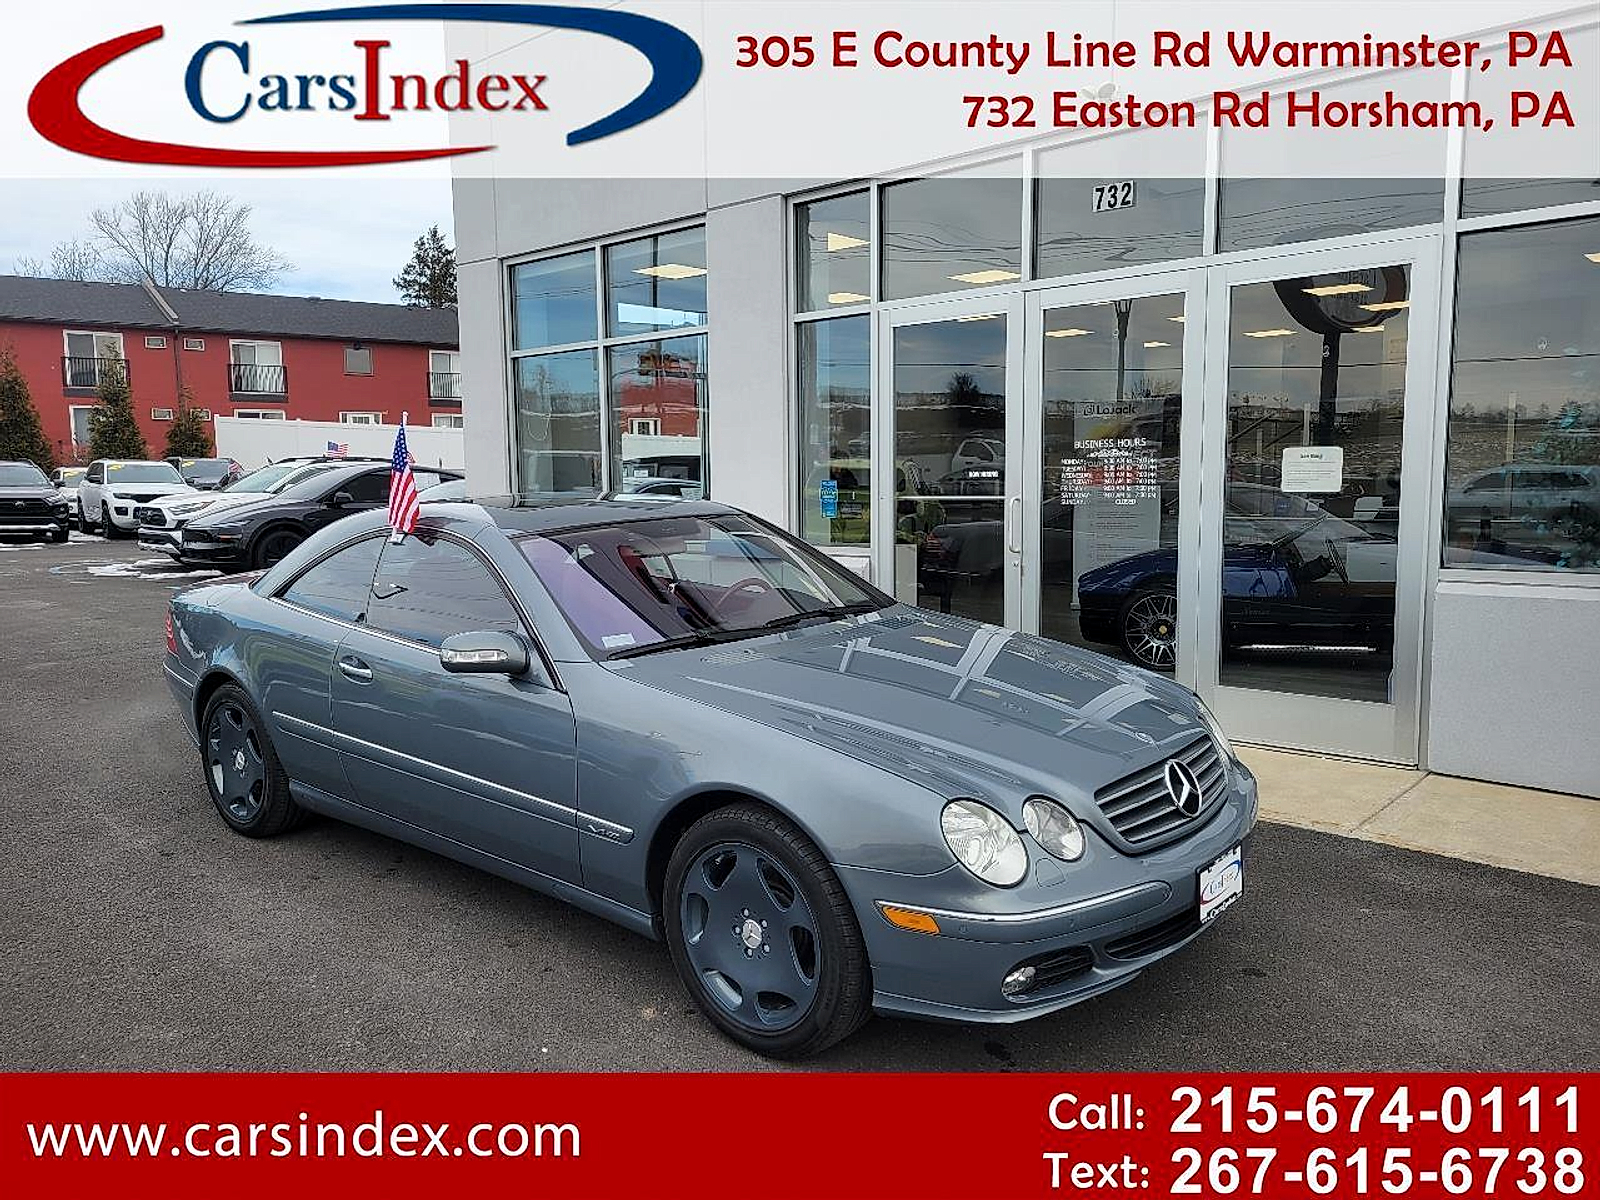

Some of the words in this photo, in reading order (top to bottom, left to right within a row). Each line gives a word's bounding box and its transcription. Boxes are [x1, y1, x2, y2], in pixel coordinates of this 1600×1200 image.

[1095, 182, 1131, 209] 732
[1074, 439, 1114, 449] BUSINESS
[1117, 437, 1147, 447] HOURS
